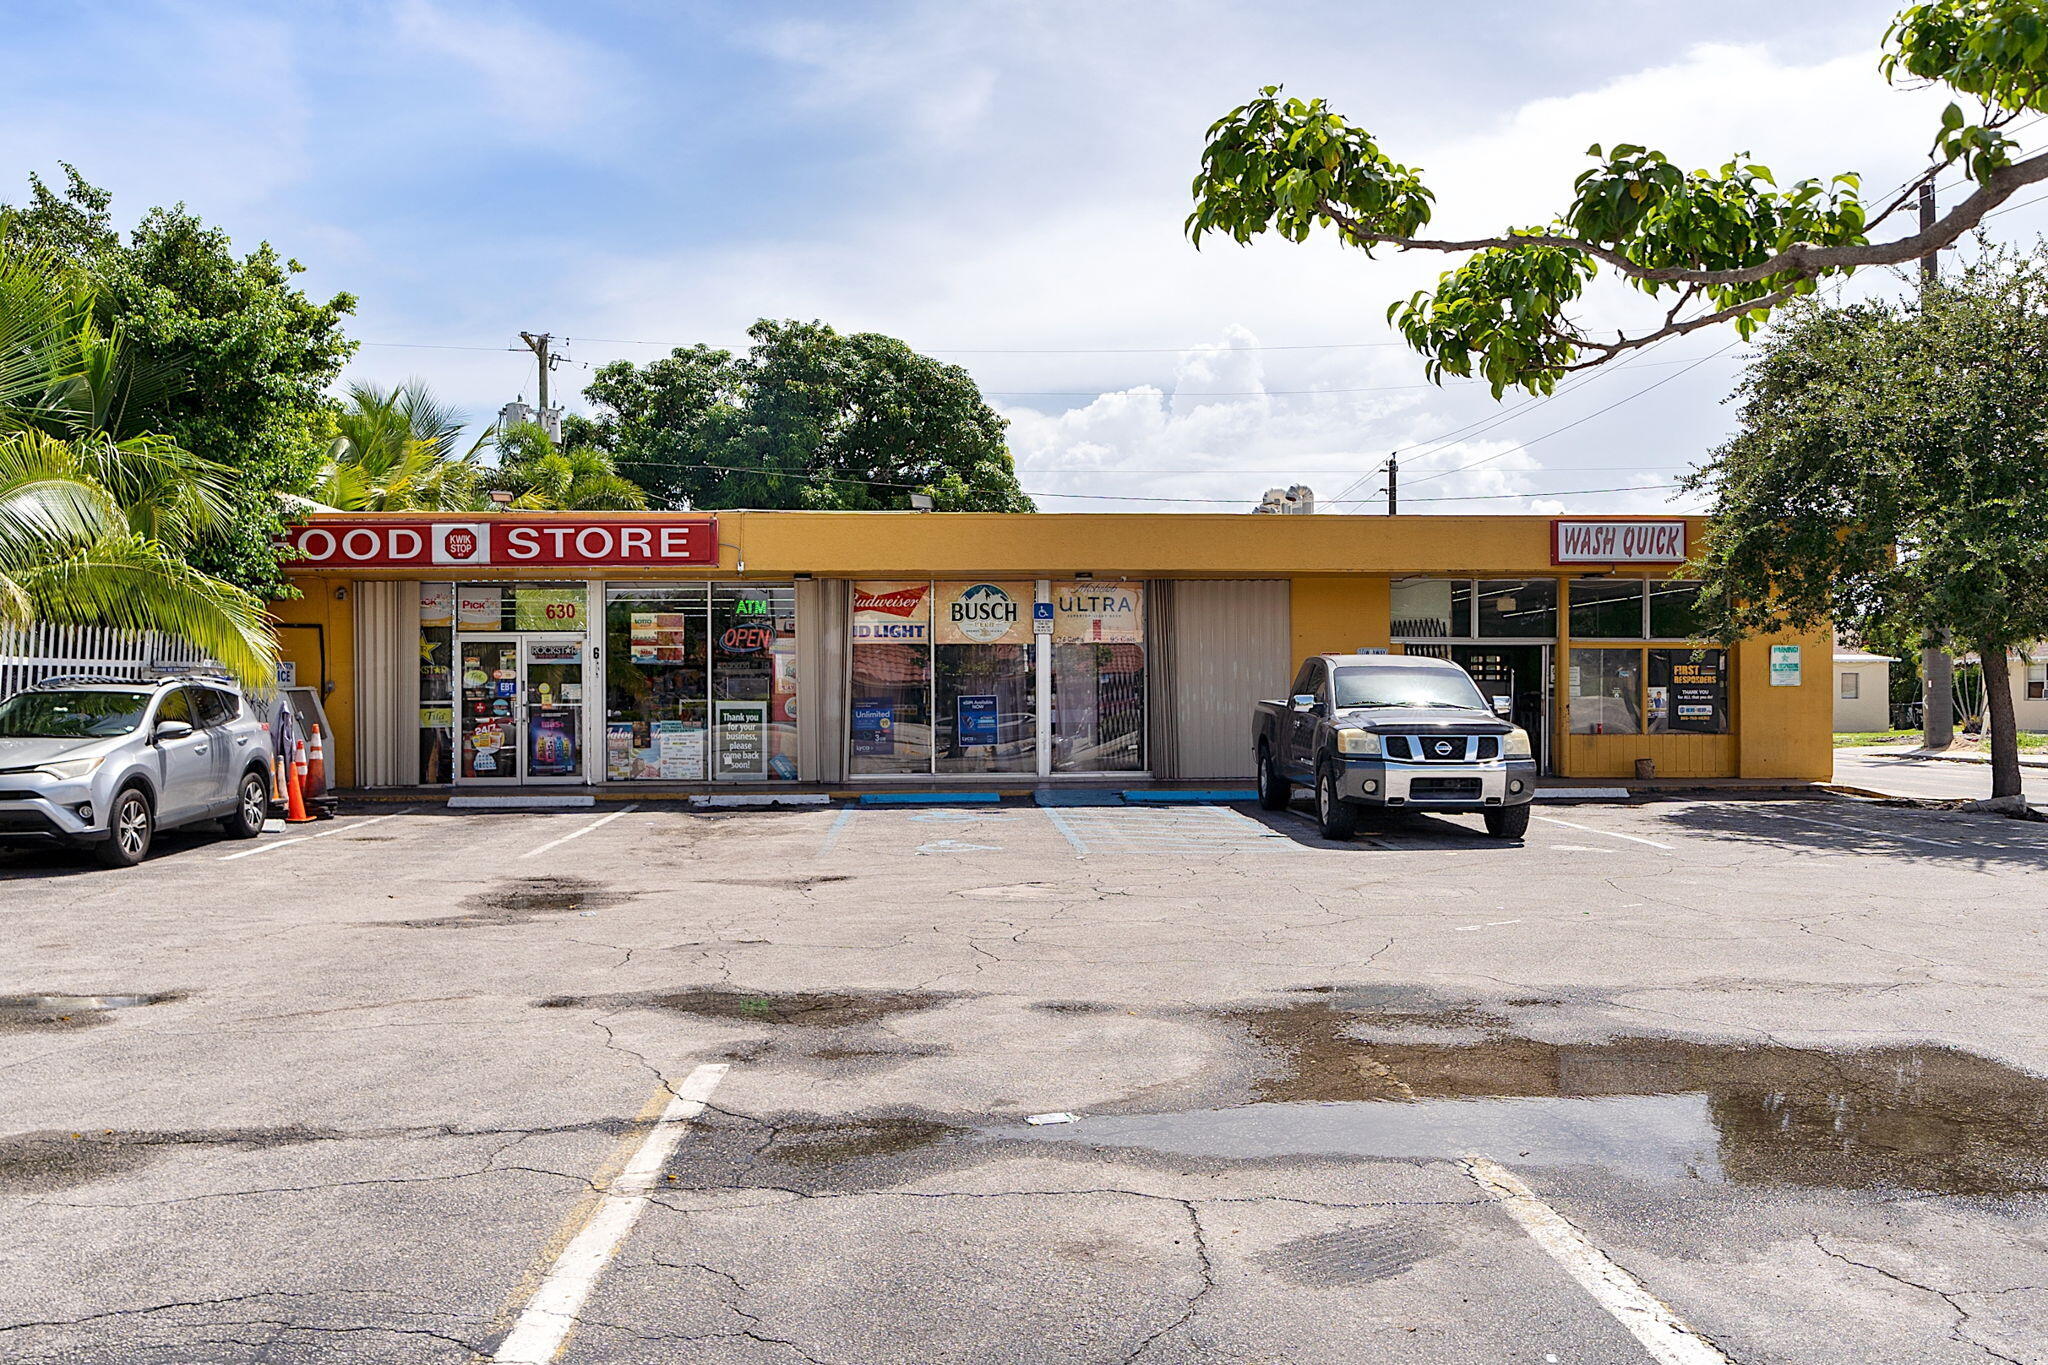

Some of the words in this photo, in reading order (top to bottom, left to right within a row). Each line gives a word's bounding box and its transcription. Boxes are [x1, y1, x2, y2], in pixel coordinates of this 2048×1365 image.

[449, 534, 471, 544] KWIK
[507, 527, 690, 559] STORE
[1565, 527, 1616, 555] WASH
[1623, 526, 1680, 557] QUICK
[450, 544, 472, 553] STOP
[736, 600, 767, 614] ATM
[1059, 596, 1132, 612] ULTRA
[545, 604, 576, 619] 630
[951, 602, 1017, 622] BUSCH
[853, 624, 871, 638] D
[873, 624, 925, 638] LIGHT
[724, 628, 771, 648] OPEN
[593, 646, 600, 660] 6
[1673, 665, 1700, 676] FIRST
[277, 670, 291, 682] ICE
[1673, 675, 1717, 684] RESPONDERS
[500, 682, 515, 691] EBT
[722, 713, 745, 721] Thank
[745, 714, 759, 723] you
[855, 710, 891, 719] Unlimited
[727, 722, 738, 731] for
[739, 724, 756, 732] your
[726, 731, 758, 741] business,
[729, 741, 752, 751] please
[722, 752, 741, 760] come
[742, 751, 759, 760] back
[730, 761, 751, 769] soon!
